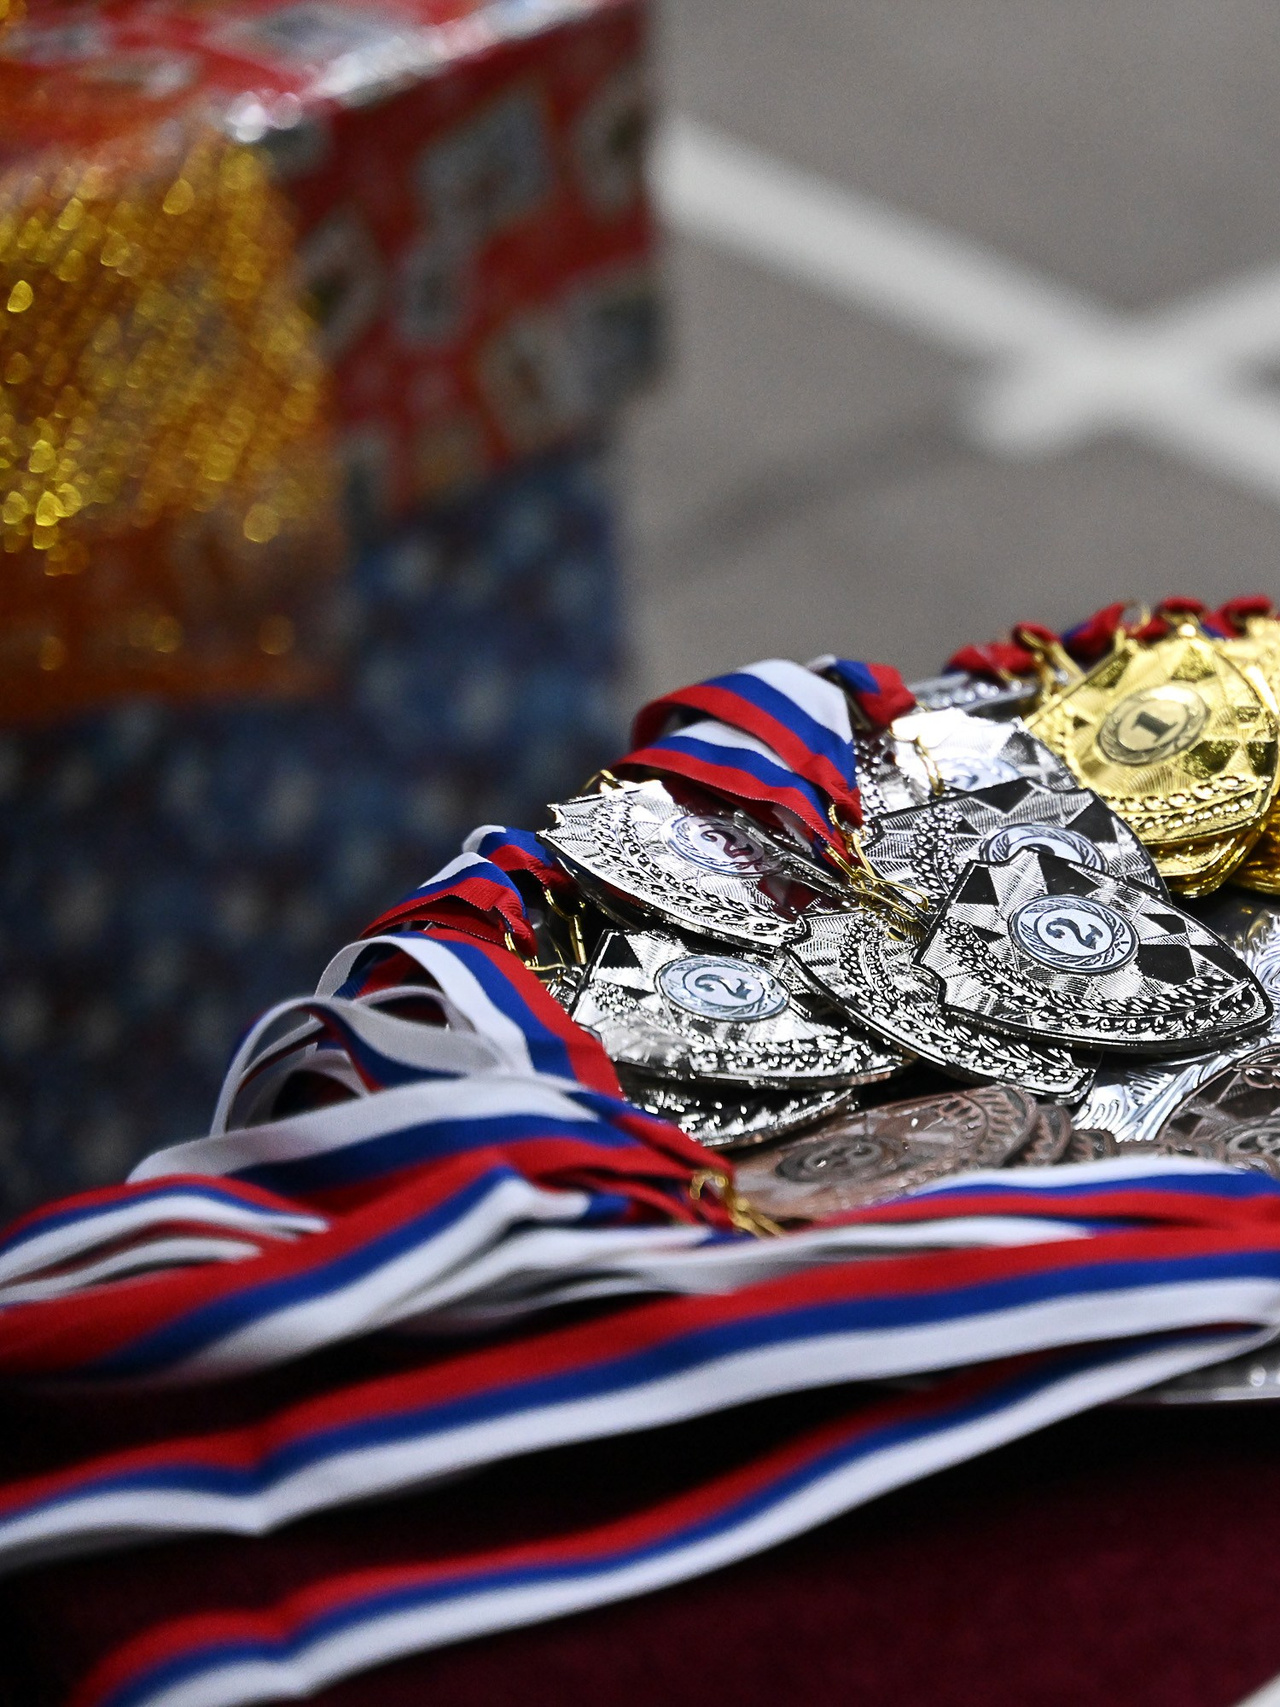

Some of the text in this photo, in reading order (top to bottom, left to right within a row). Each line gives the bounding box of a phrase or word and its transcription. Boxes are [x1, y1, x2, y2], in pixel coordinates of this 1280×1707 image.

[1132, 711, 1178, 742] 1
[701, 829, 755, 858] 2
[1046, 917, 1103, 950] 2
[695, 974, 752, 1000] 2
